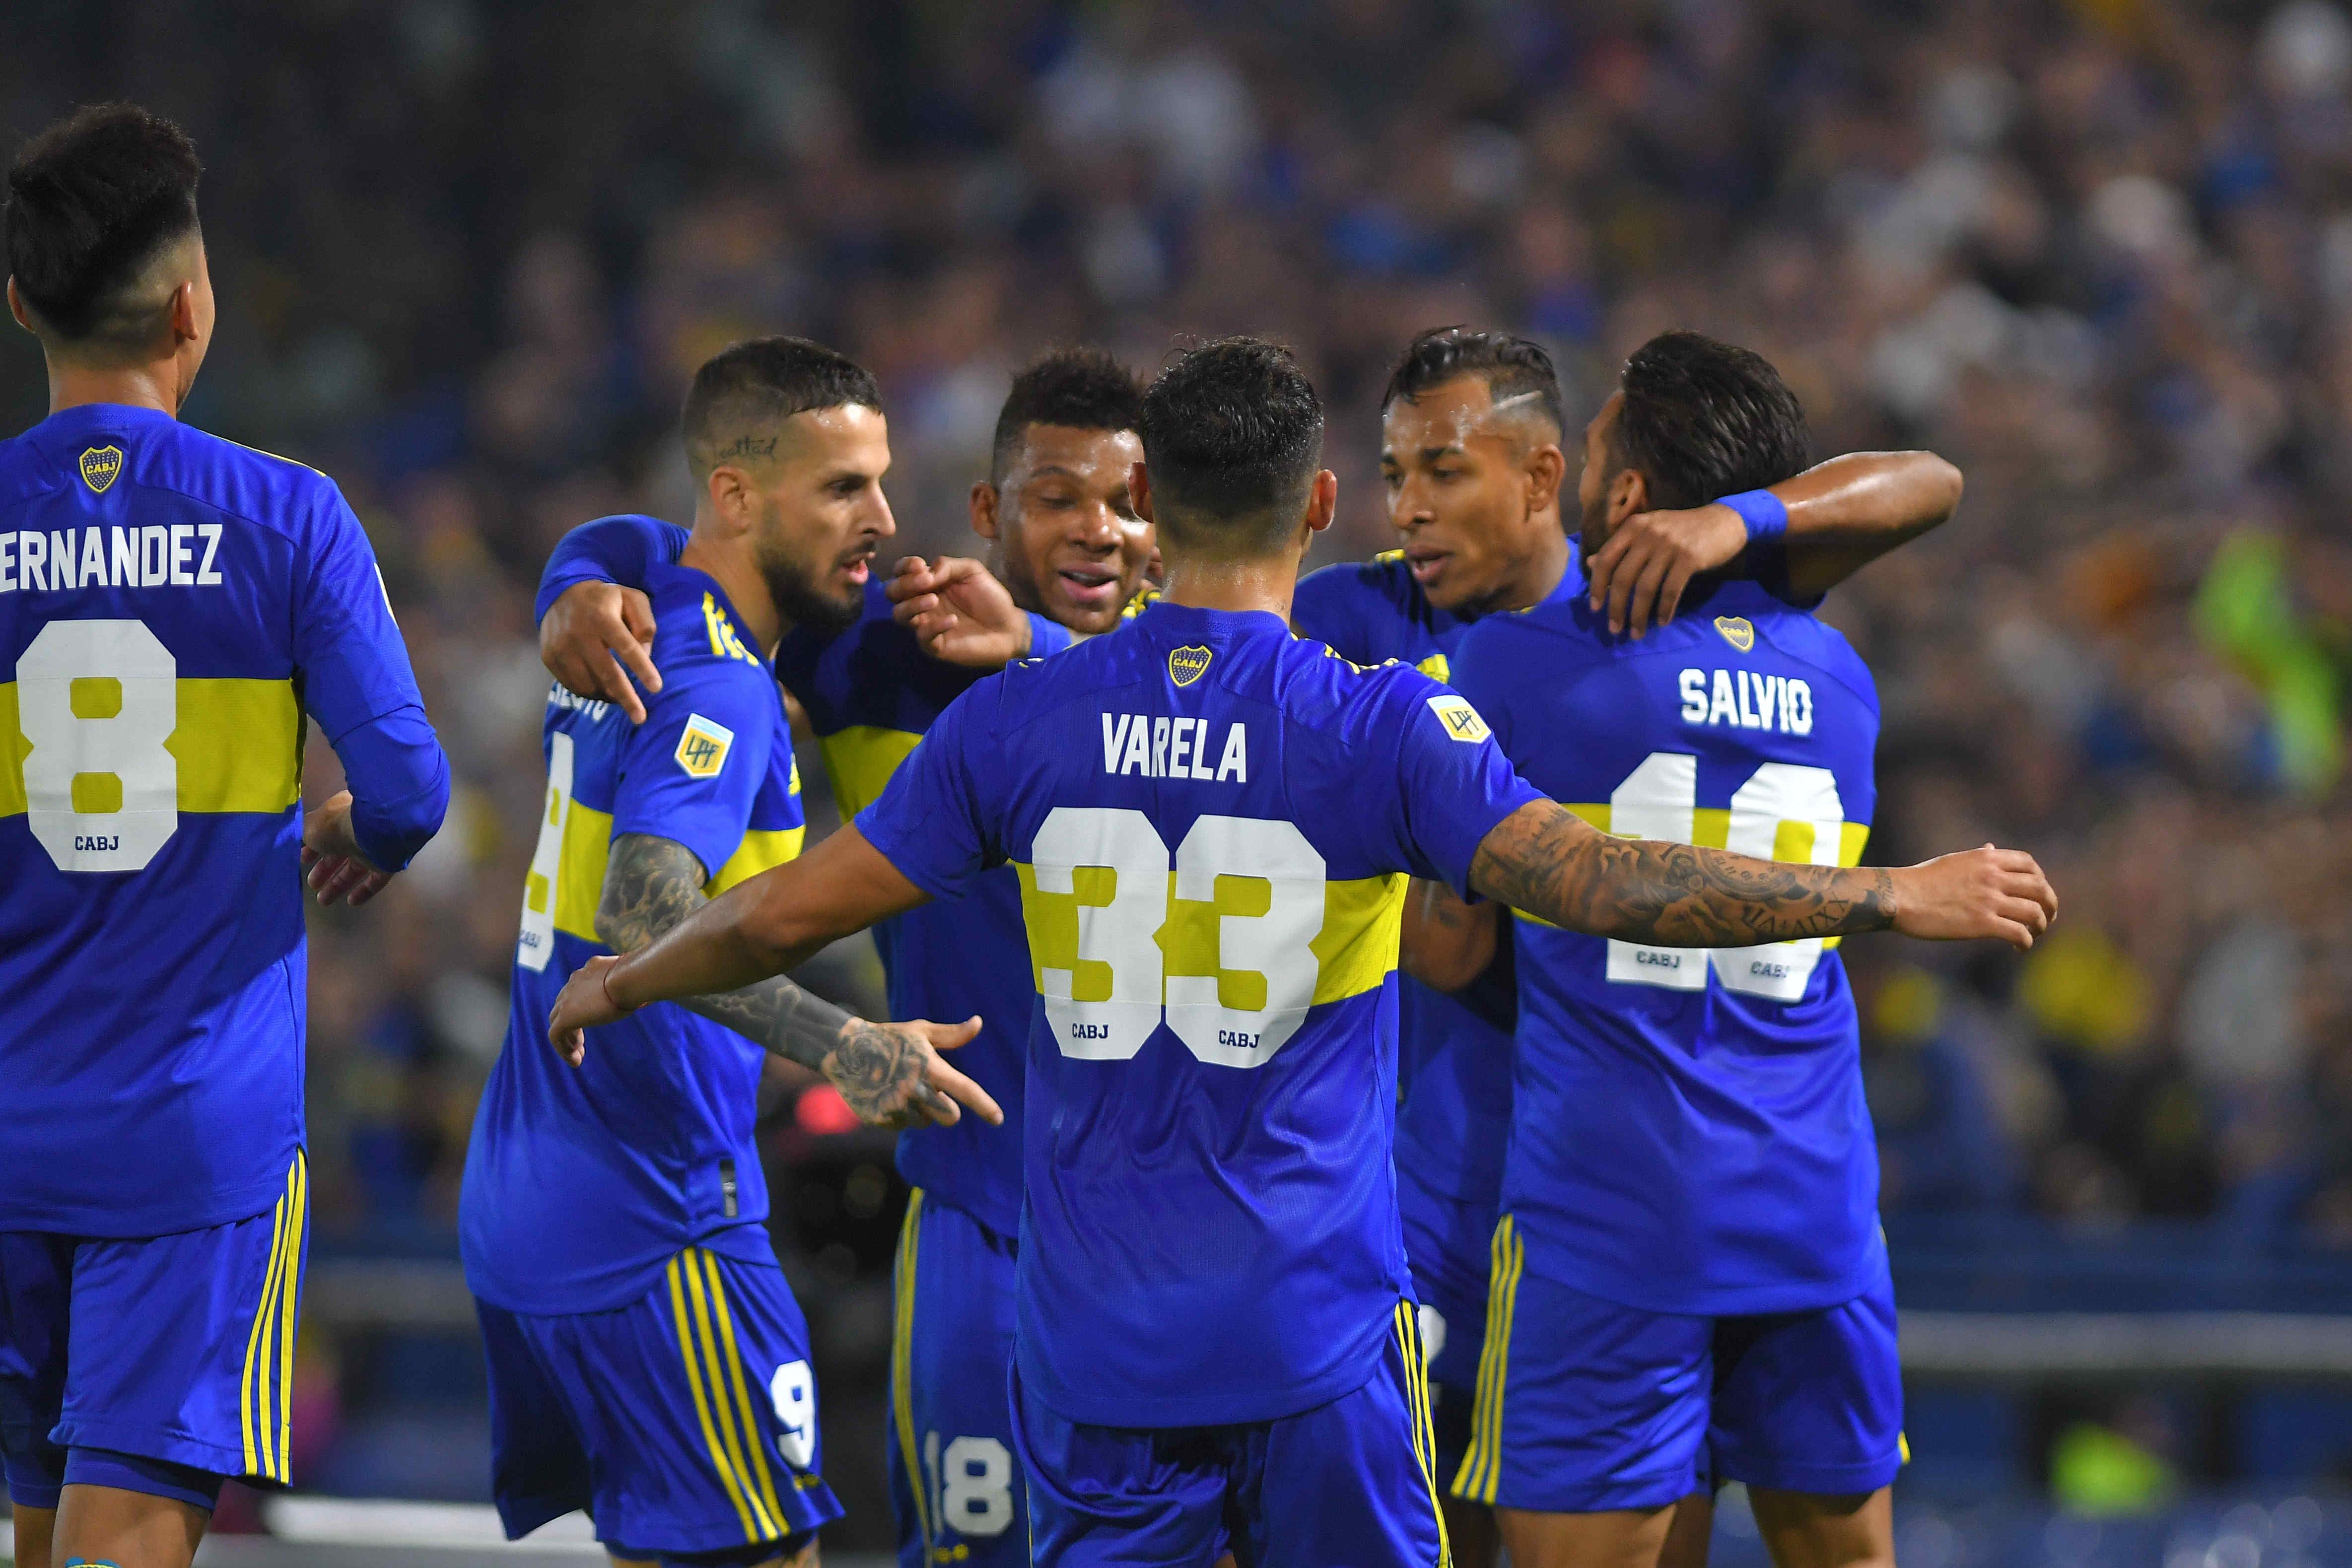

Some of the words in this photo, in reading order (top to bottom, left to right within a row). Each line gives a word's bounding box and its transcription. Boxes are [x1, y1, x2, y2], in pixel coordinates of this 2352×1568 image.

[86, 462, 116, 474] CABJ
[0, 524, 222, 593] ERNANDEZ
[1174, 658, 1203, 669] CABJ
[1678, 668, 1813, 735] SALVIO
[15, 619, 178, 872] 8
[1102, 712, 1246, 783] VARELA
[74, 836, 119, 851] CABJ
[1032, 807, 1326, 1069] 33
[1636, 950, 1681, 968] CABJ
[1072, 1023, 1108, 1040] CABJ
[1218, 1029, 1260, 1049] CABJ
[770, 1359, 816, 1469] 9
[924, 1430, 1014, 1537] 18
